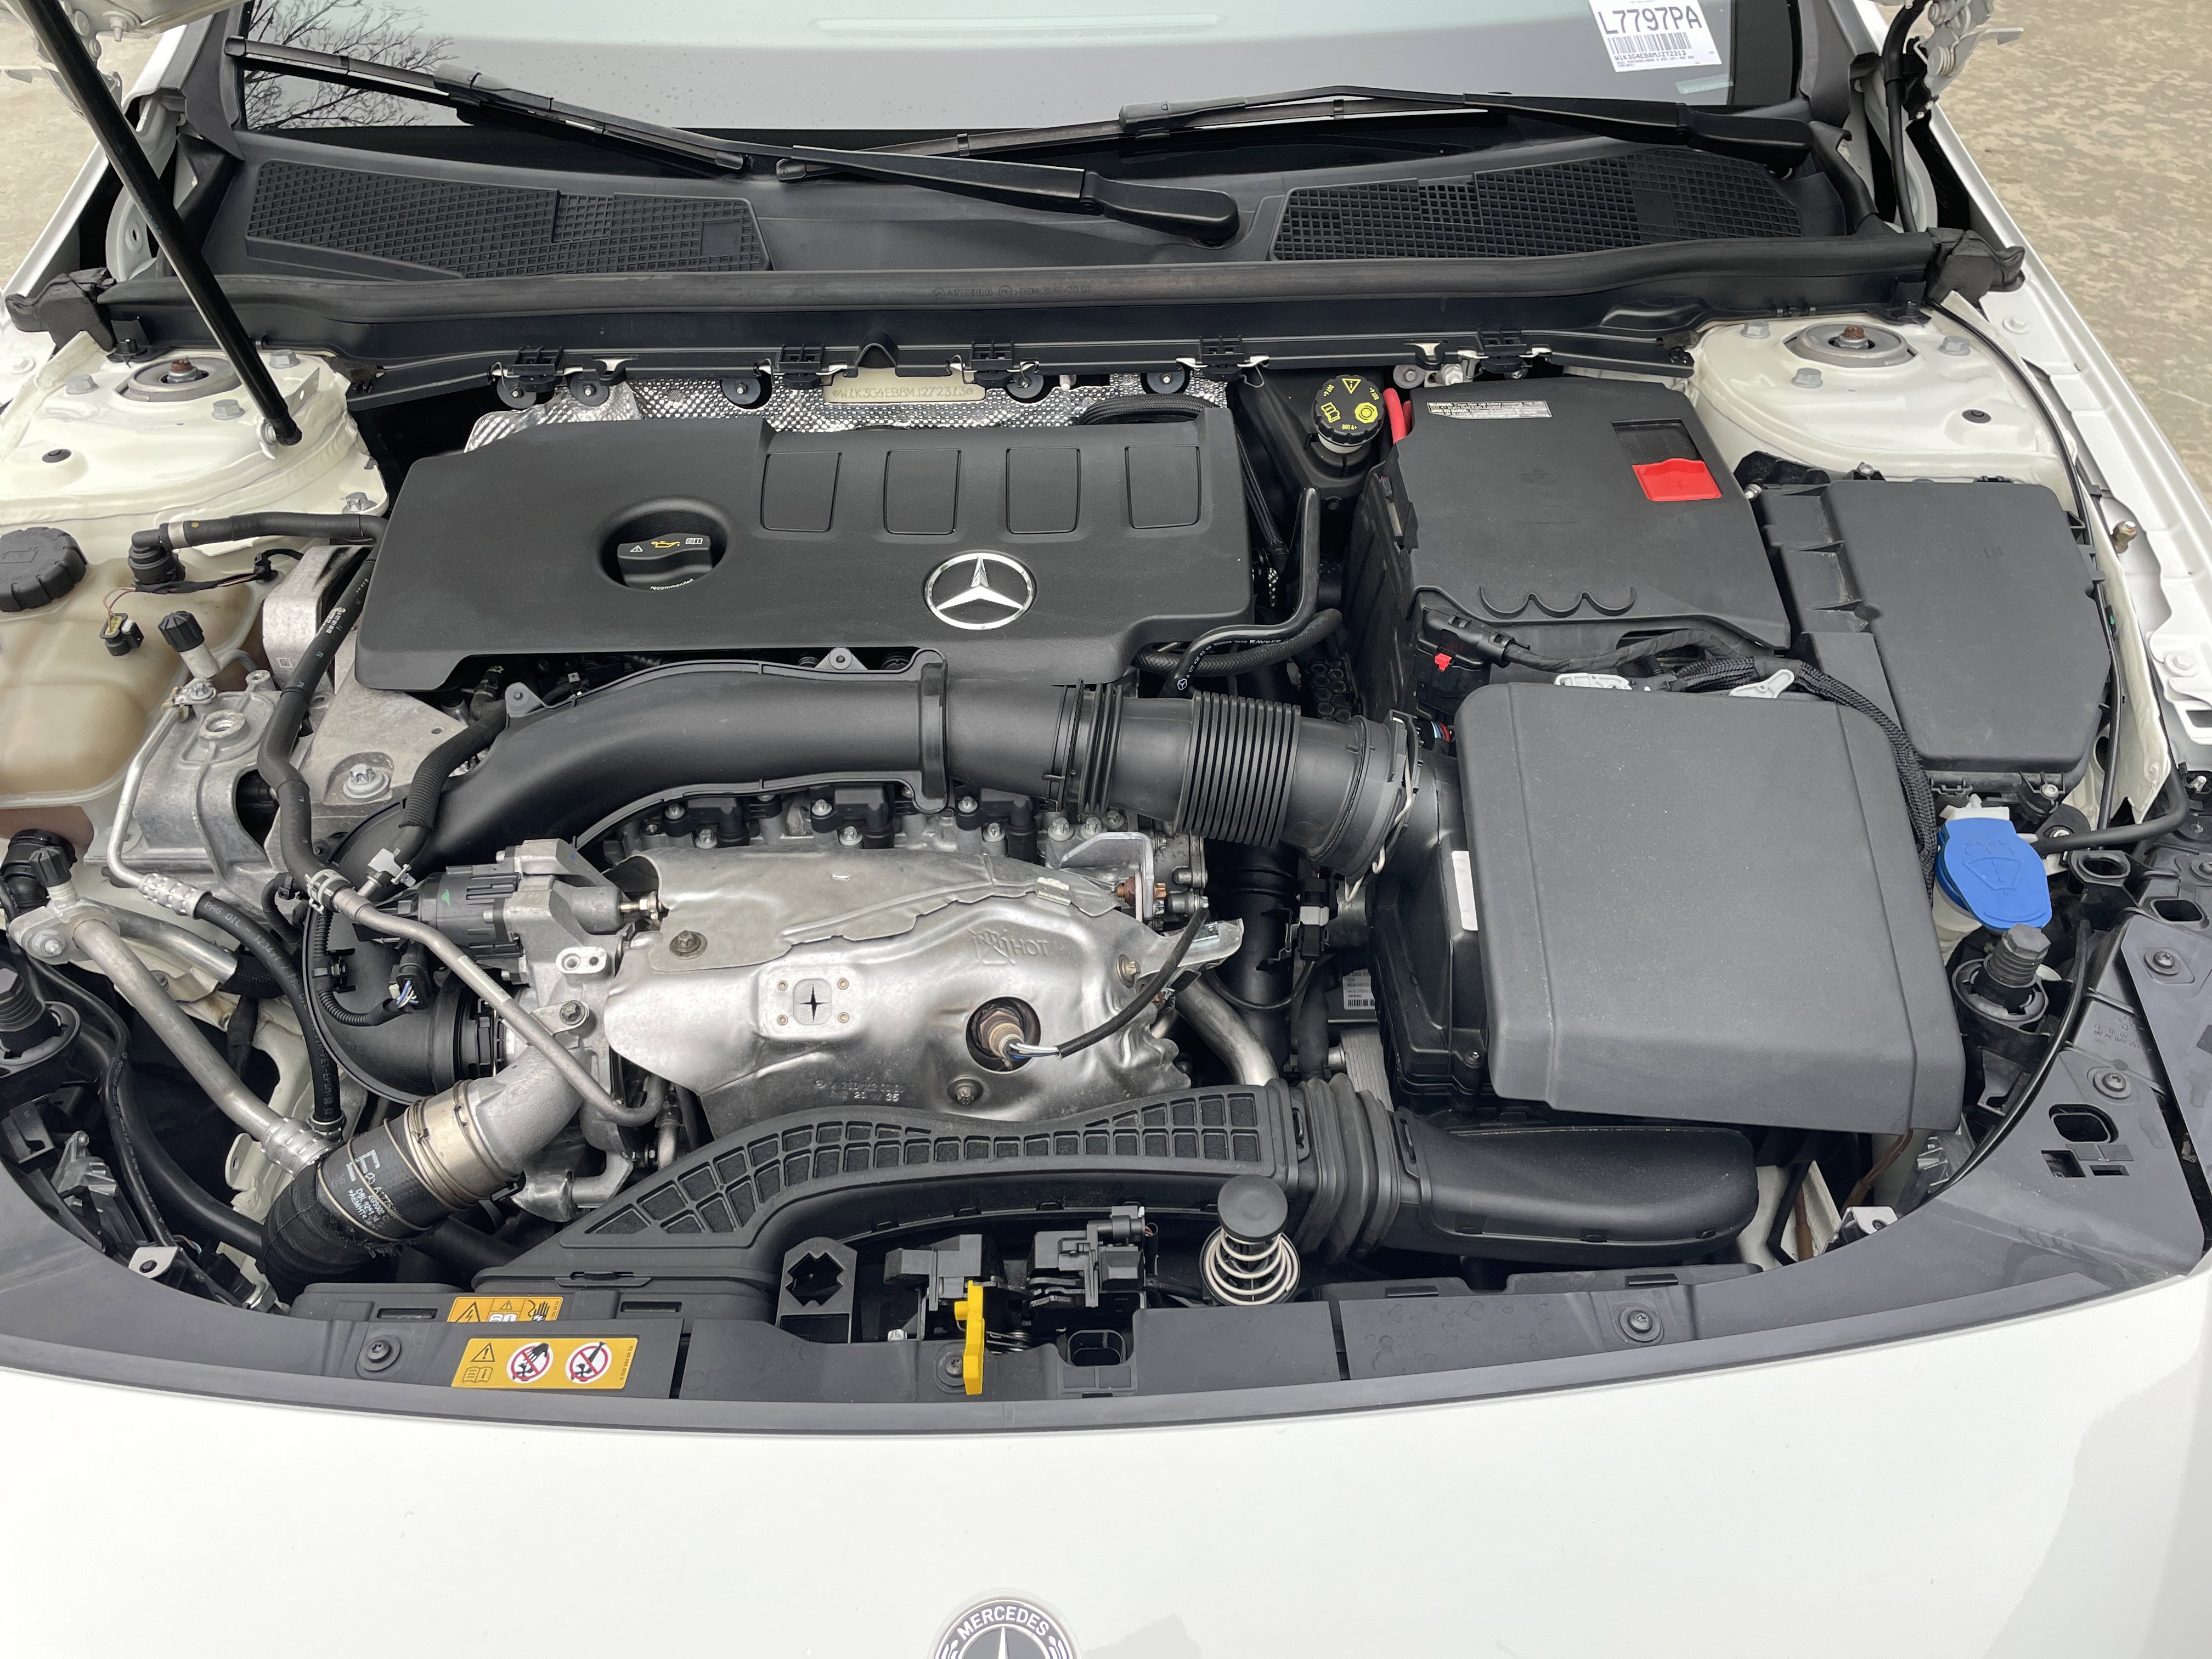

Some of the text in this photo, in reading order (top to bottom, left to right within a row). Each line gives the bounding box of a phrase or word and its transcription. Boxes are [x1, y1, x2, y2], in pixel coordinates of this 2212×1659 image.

[1598, 5, 1702, 35] L7797PA
[840, 386, 967, 398] W1K3G4EB8MJ272313
[204, 901, 223, 915] PAG
[225, 913, 241, 928] OIL
[1011, 938, 1049, 957] HOT
[957, 1606, 1050, 1641] MERCEDES
